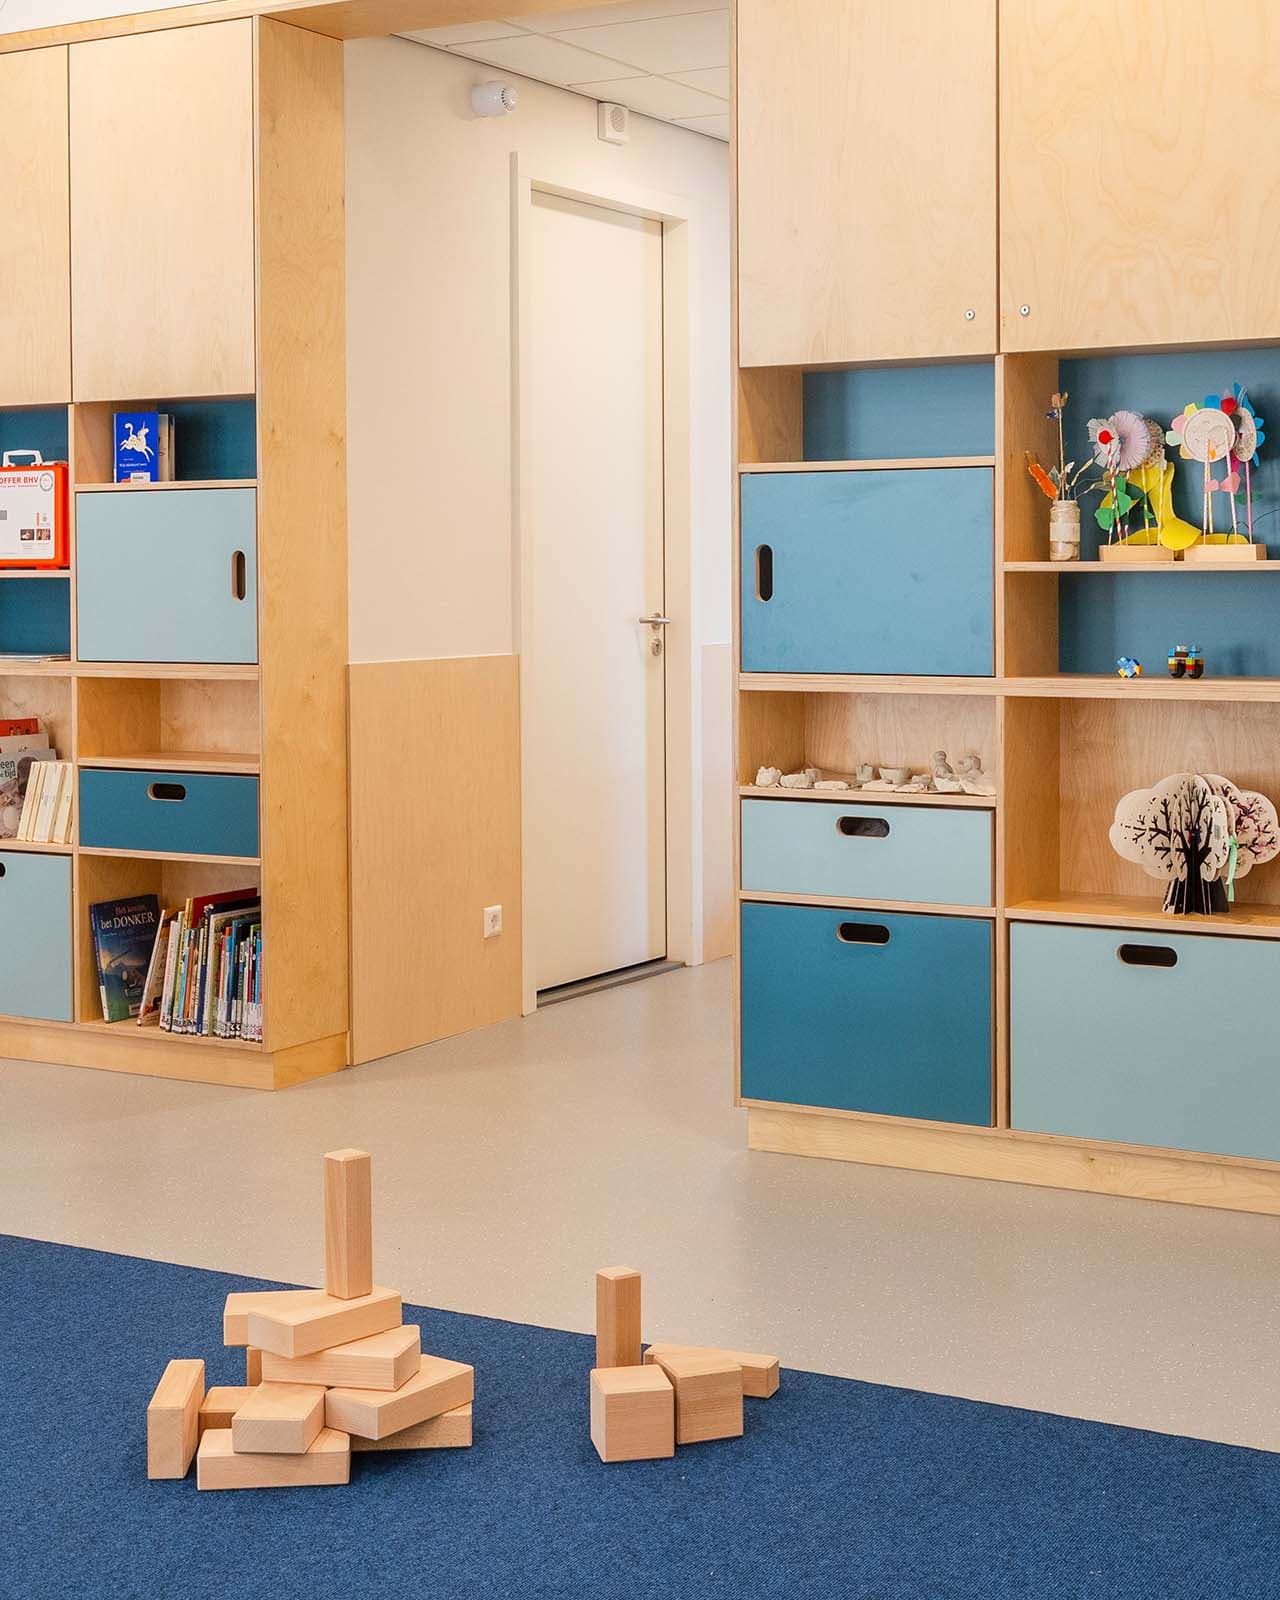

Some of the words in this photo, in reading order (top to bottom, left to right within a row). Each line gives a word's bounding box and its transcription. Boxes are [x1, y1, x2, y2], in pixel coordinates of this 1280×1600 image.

[23, 476, 39, 484] BHV
[4, 769, 16, 779] tijd
[101, 920, 112, 929] het
[114, 911, 155, 928] DONKER
